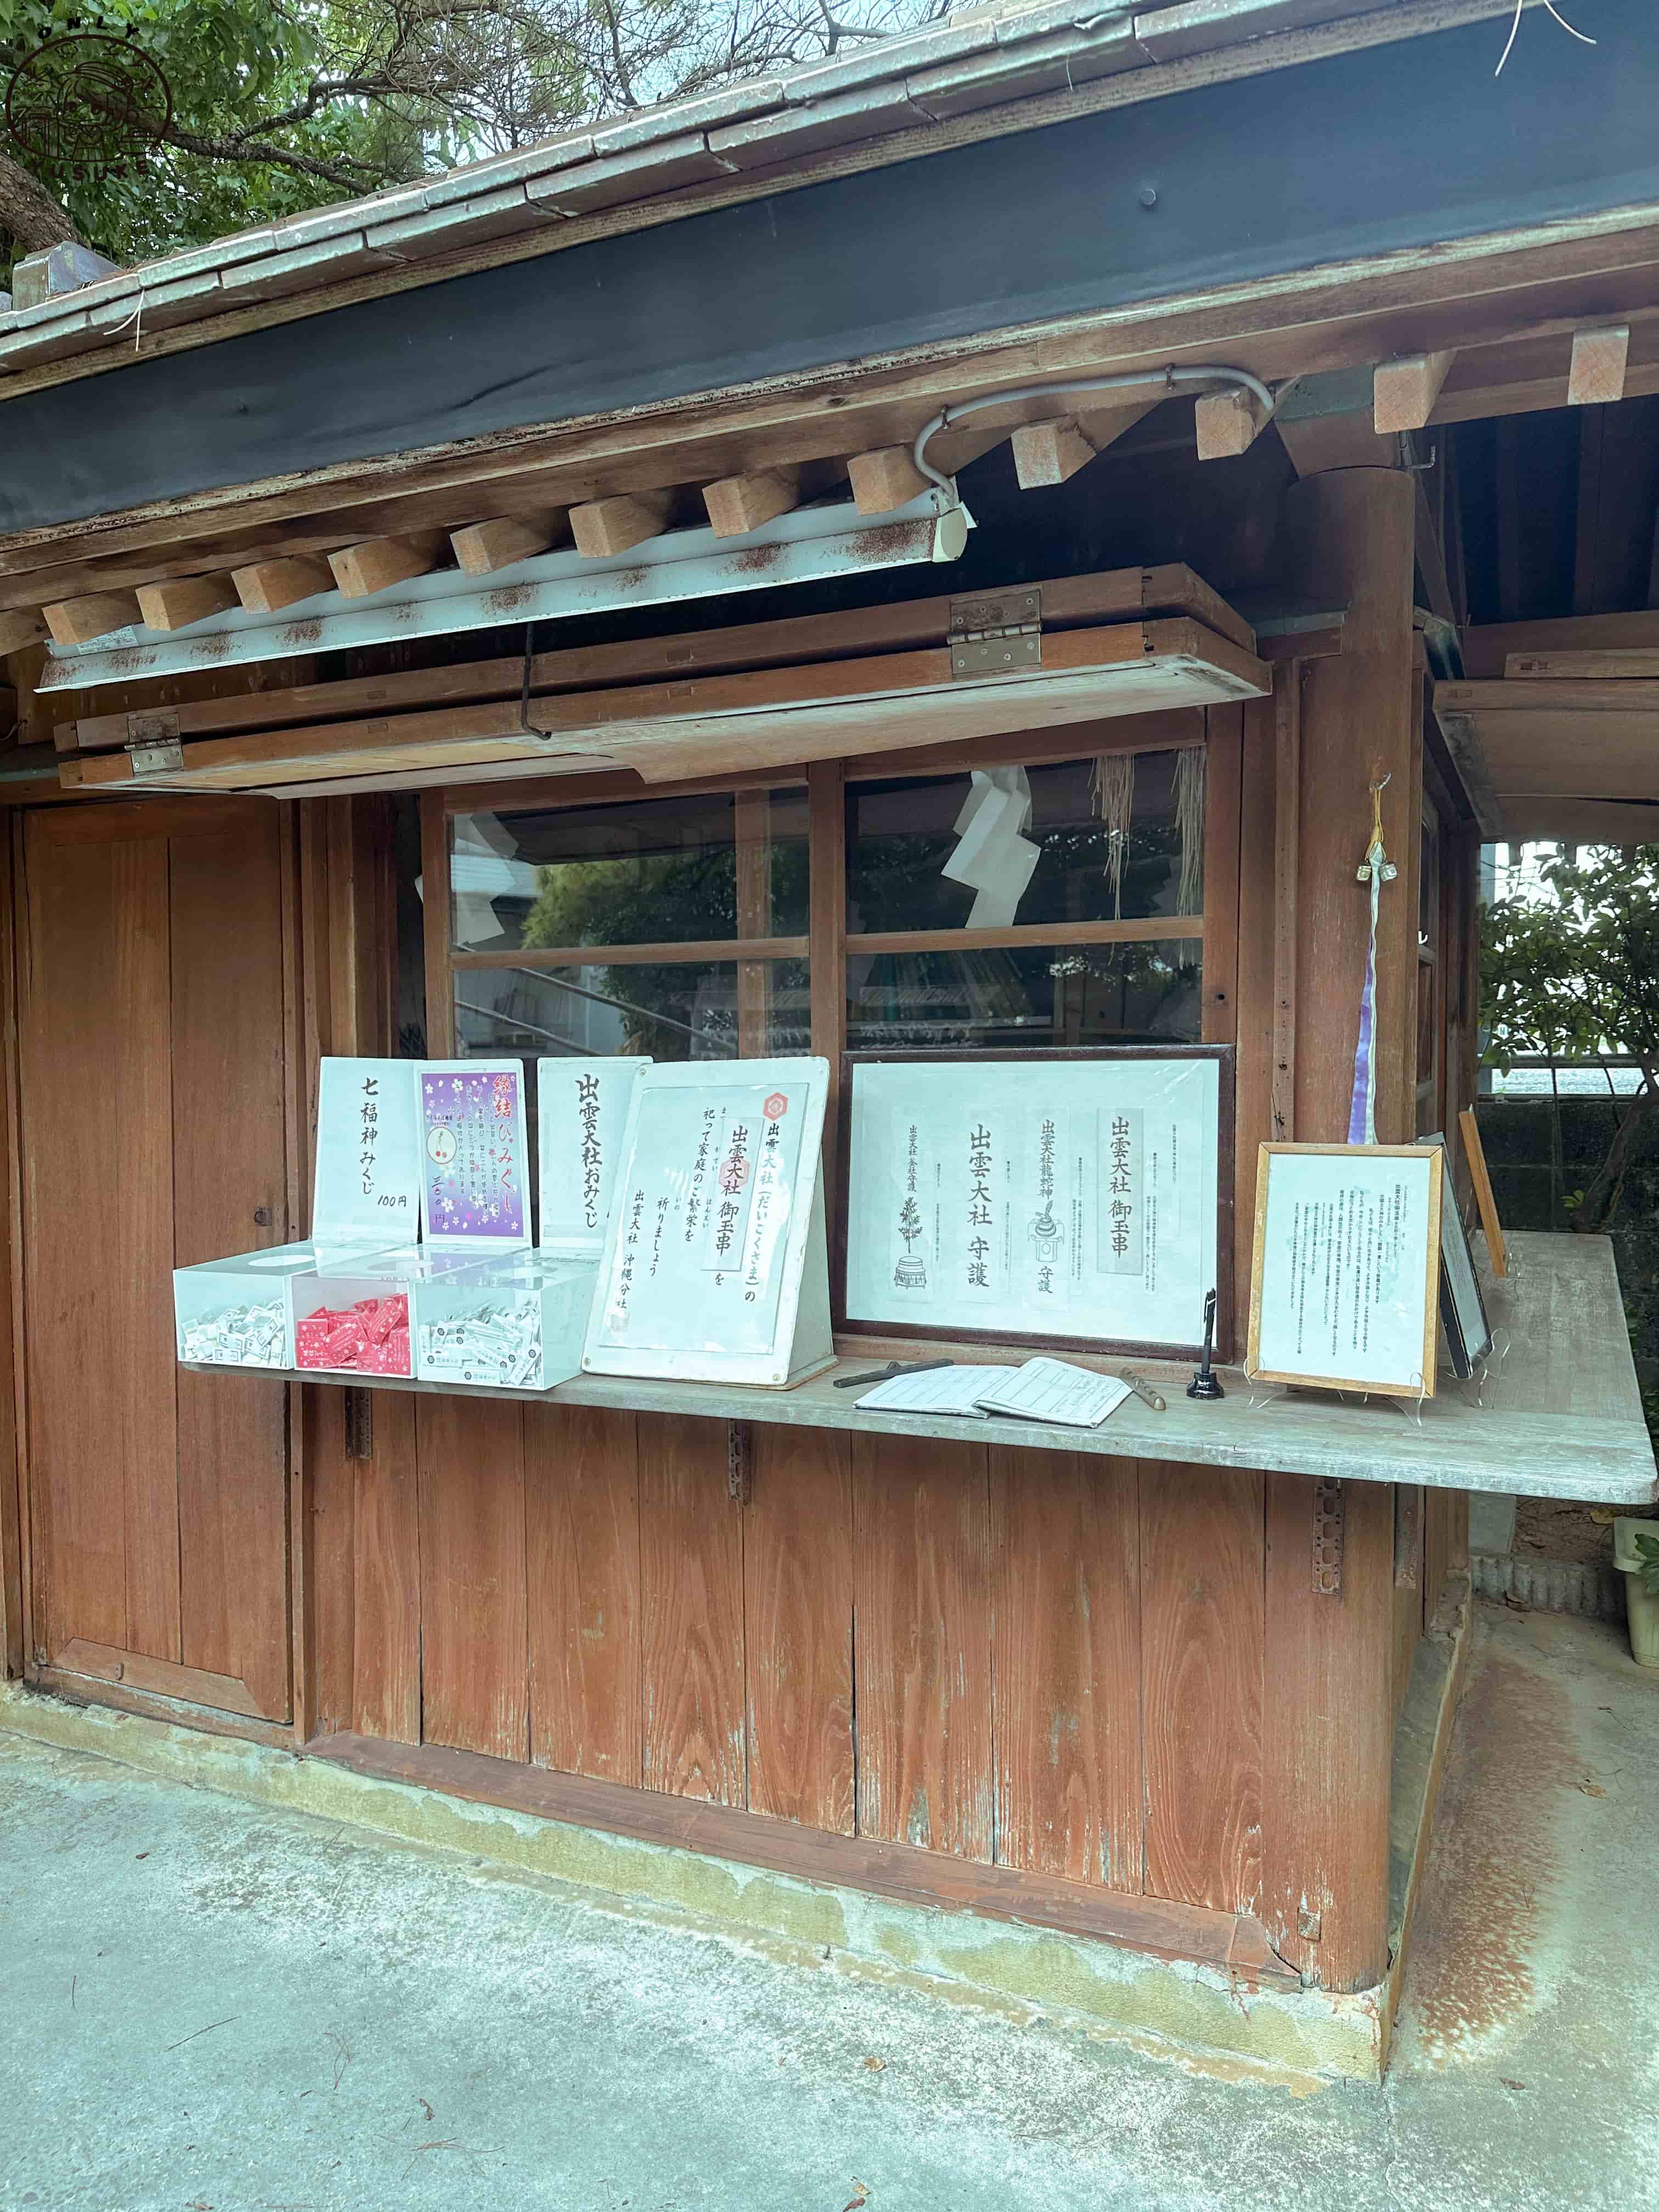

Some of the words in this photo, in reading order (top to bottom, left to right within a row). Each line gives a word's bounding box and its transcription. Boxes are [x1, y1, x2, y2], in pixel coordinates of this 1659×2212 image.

[360, 1077, 379, 1194] 七福神みくじ
[575, 1074, 602, 1228] 出雲大社おみくじ
[377, 1194, 407, 1207] 100円
[967, 1124, 992, 1226] 出雲大社
[1108, 1116, 1133, 1259] 出雲大社御玉串
[627, 1189, 644, 1244] 出雲大社
[650, 1197, 670, 1277] 祈りましょう
[715, 1273, 725, 1285] を
[967, 1236, 990, 1287] 守護
[1038, 1266, 1054, 1294] 守護
